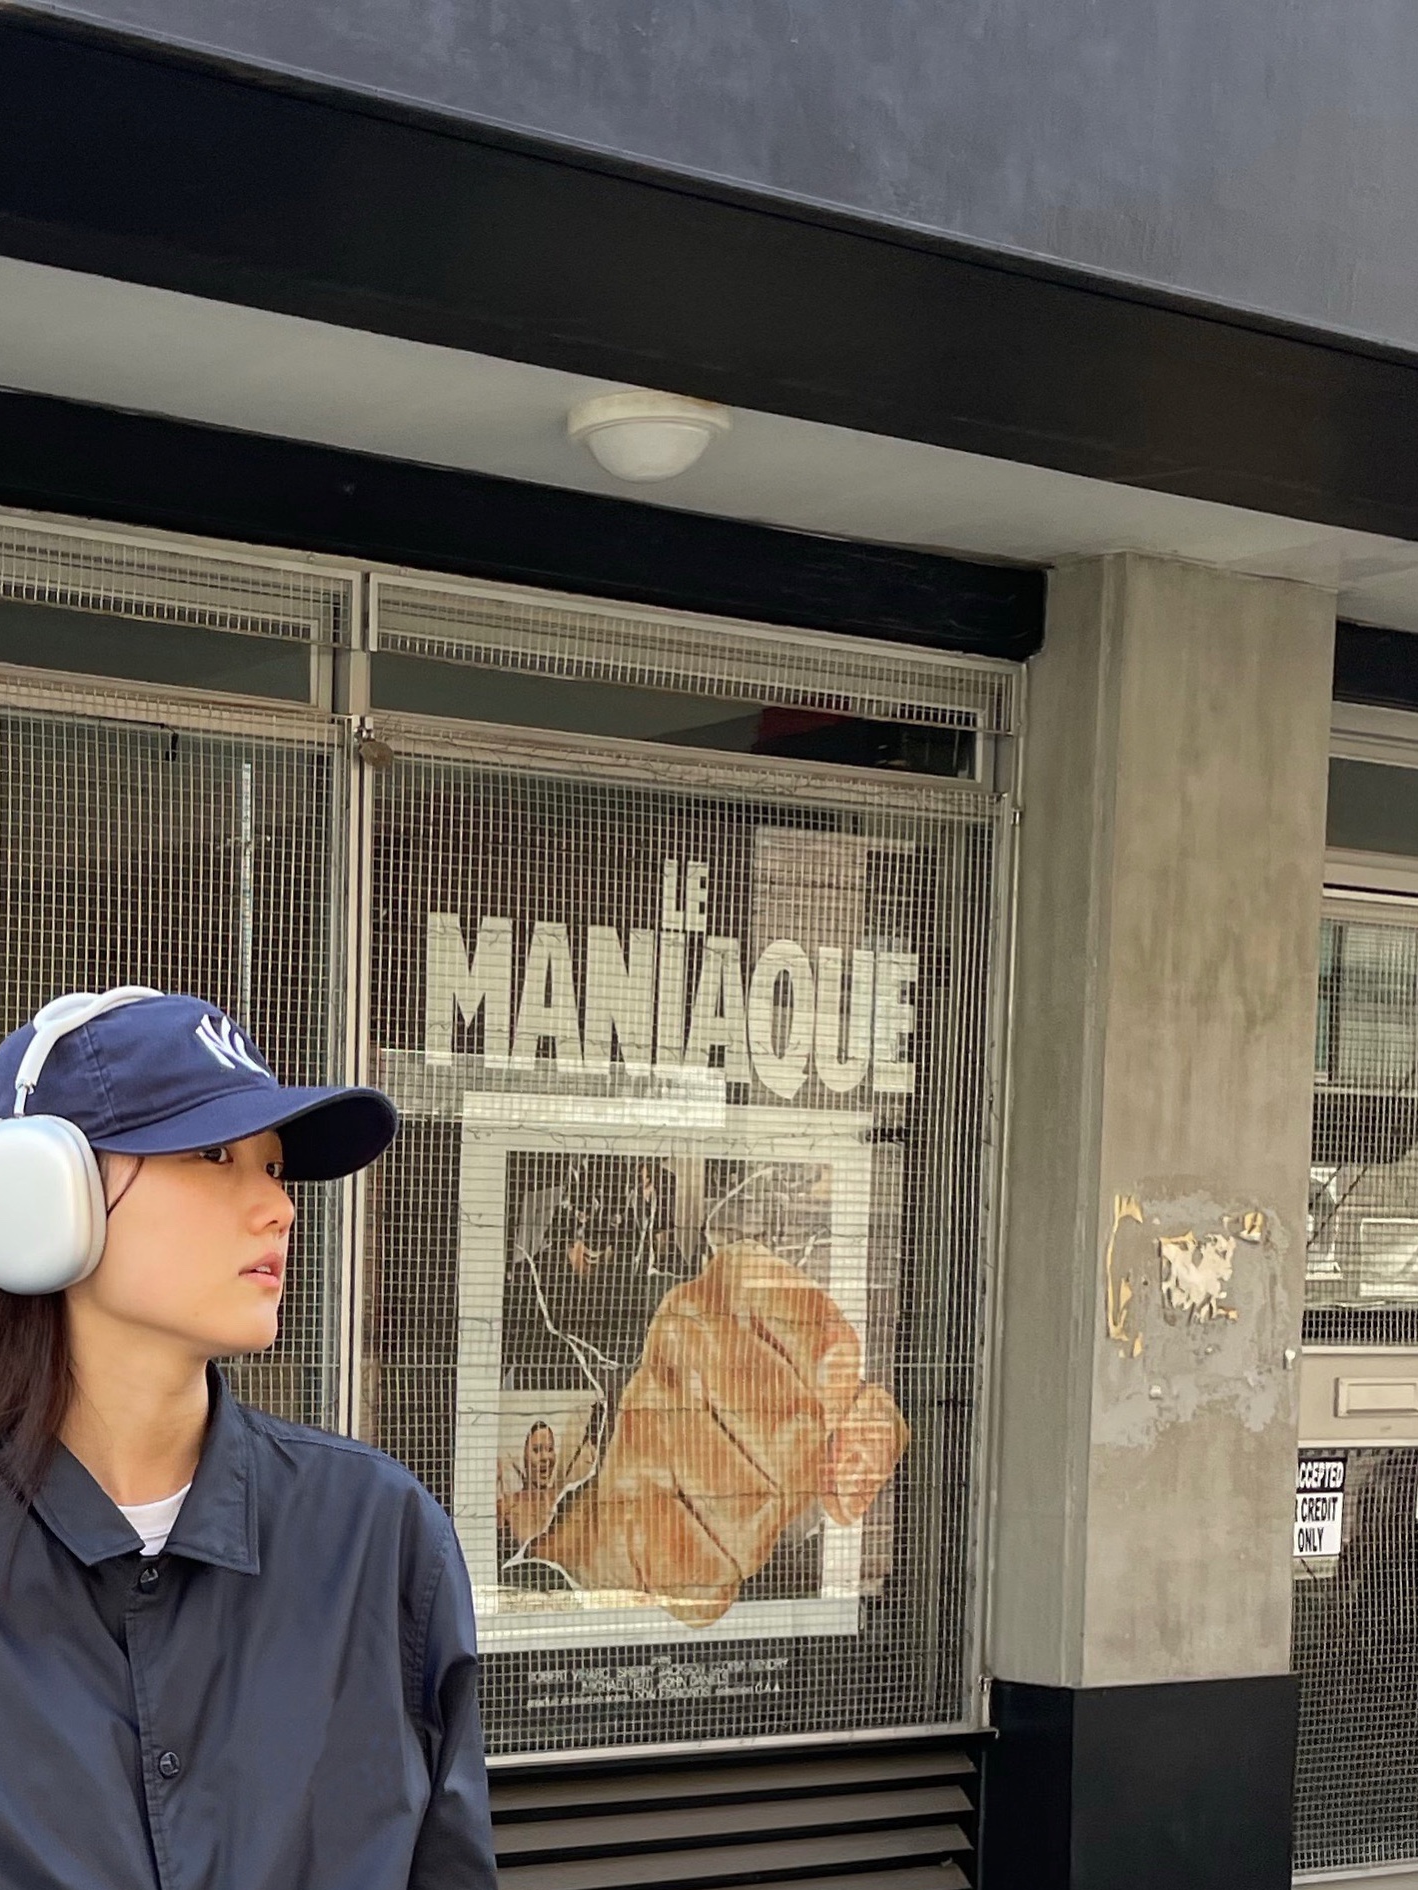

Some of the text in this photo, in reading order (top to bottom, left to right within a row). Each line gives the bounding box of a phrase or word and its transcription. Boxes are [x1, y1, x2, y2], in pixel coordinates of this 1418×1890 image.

[661, 858, 709, 932] LE
[425, 911, 919, 1099] MANIAQUE
[1296, 1461, 1344, 1489] CCEPTED
[1300, 1496, 1339, 1523] CREDIT
[1297, 1527, 1324, 1553] ONLY
